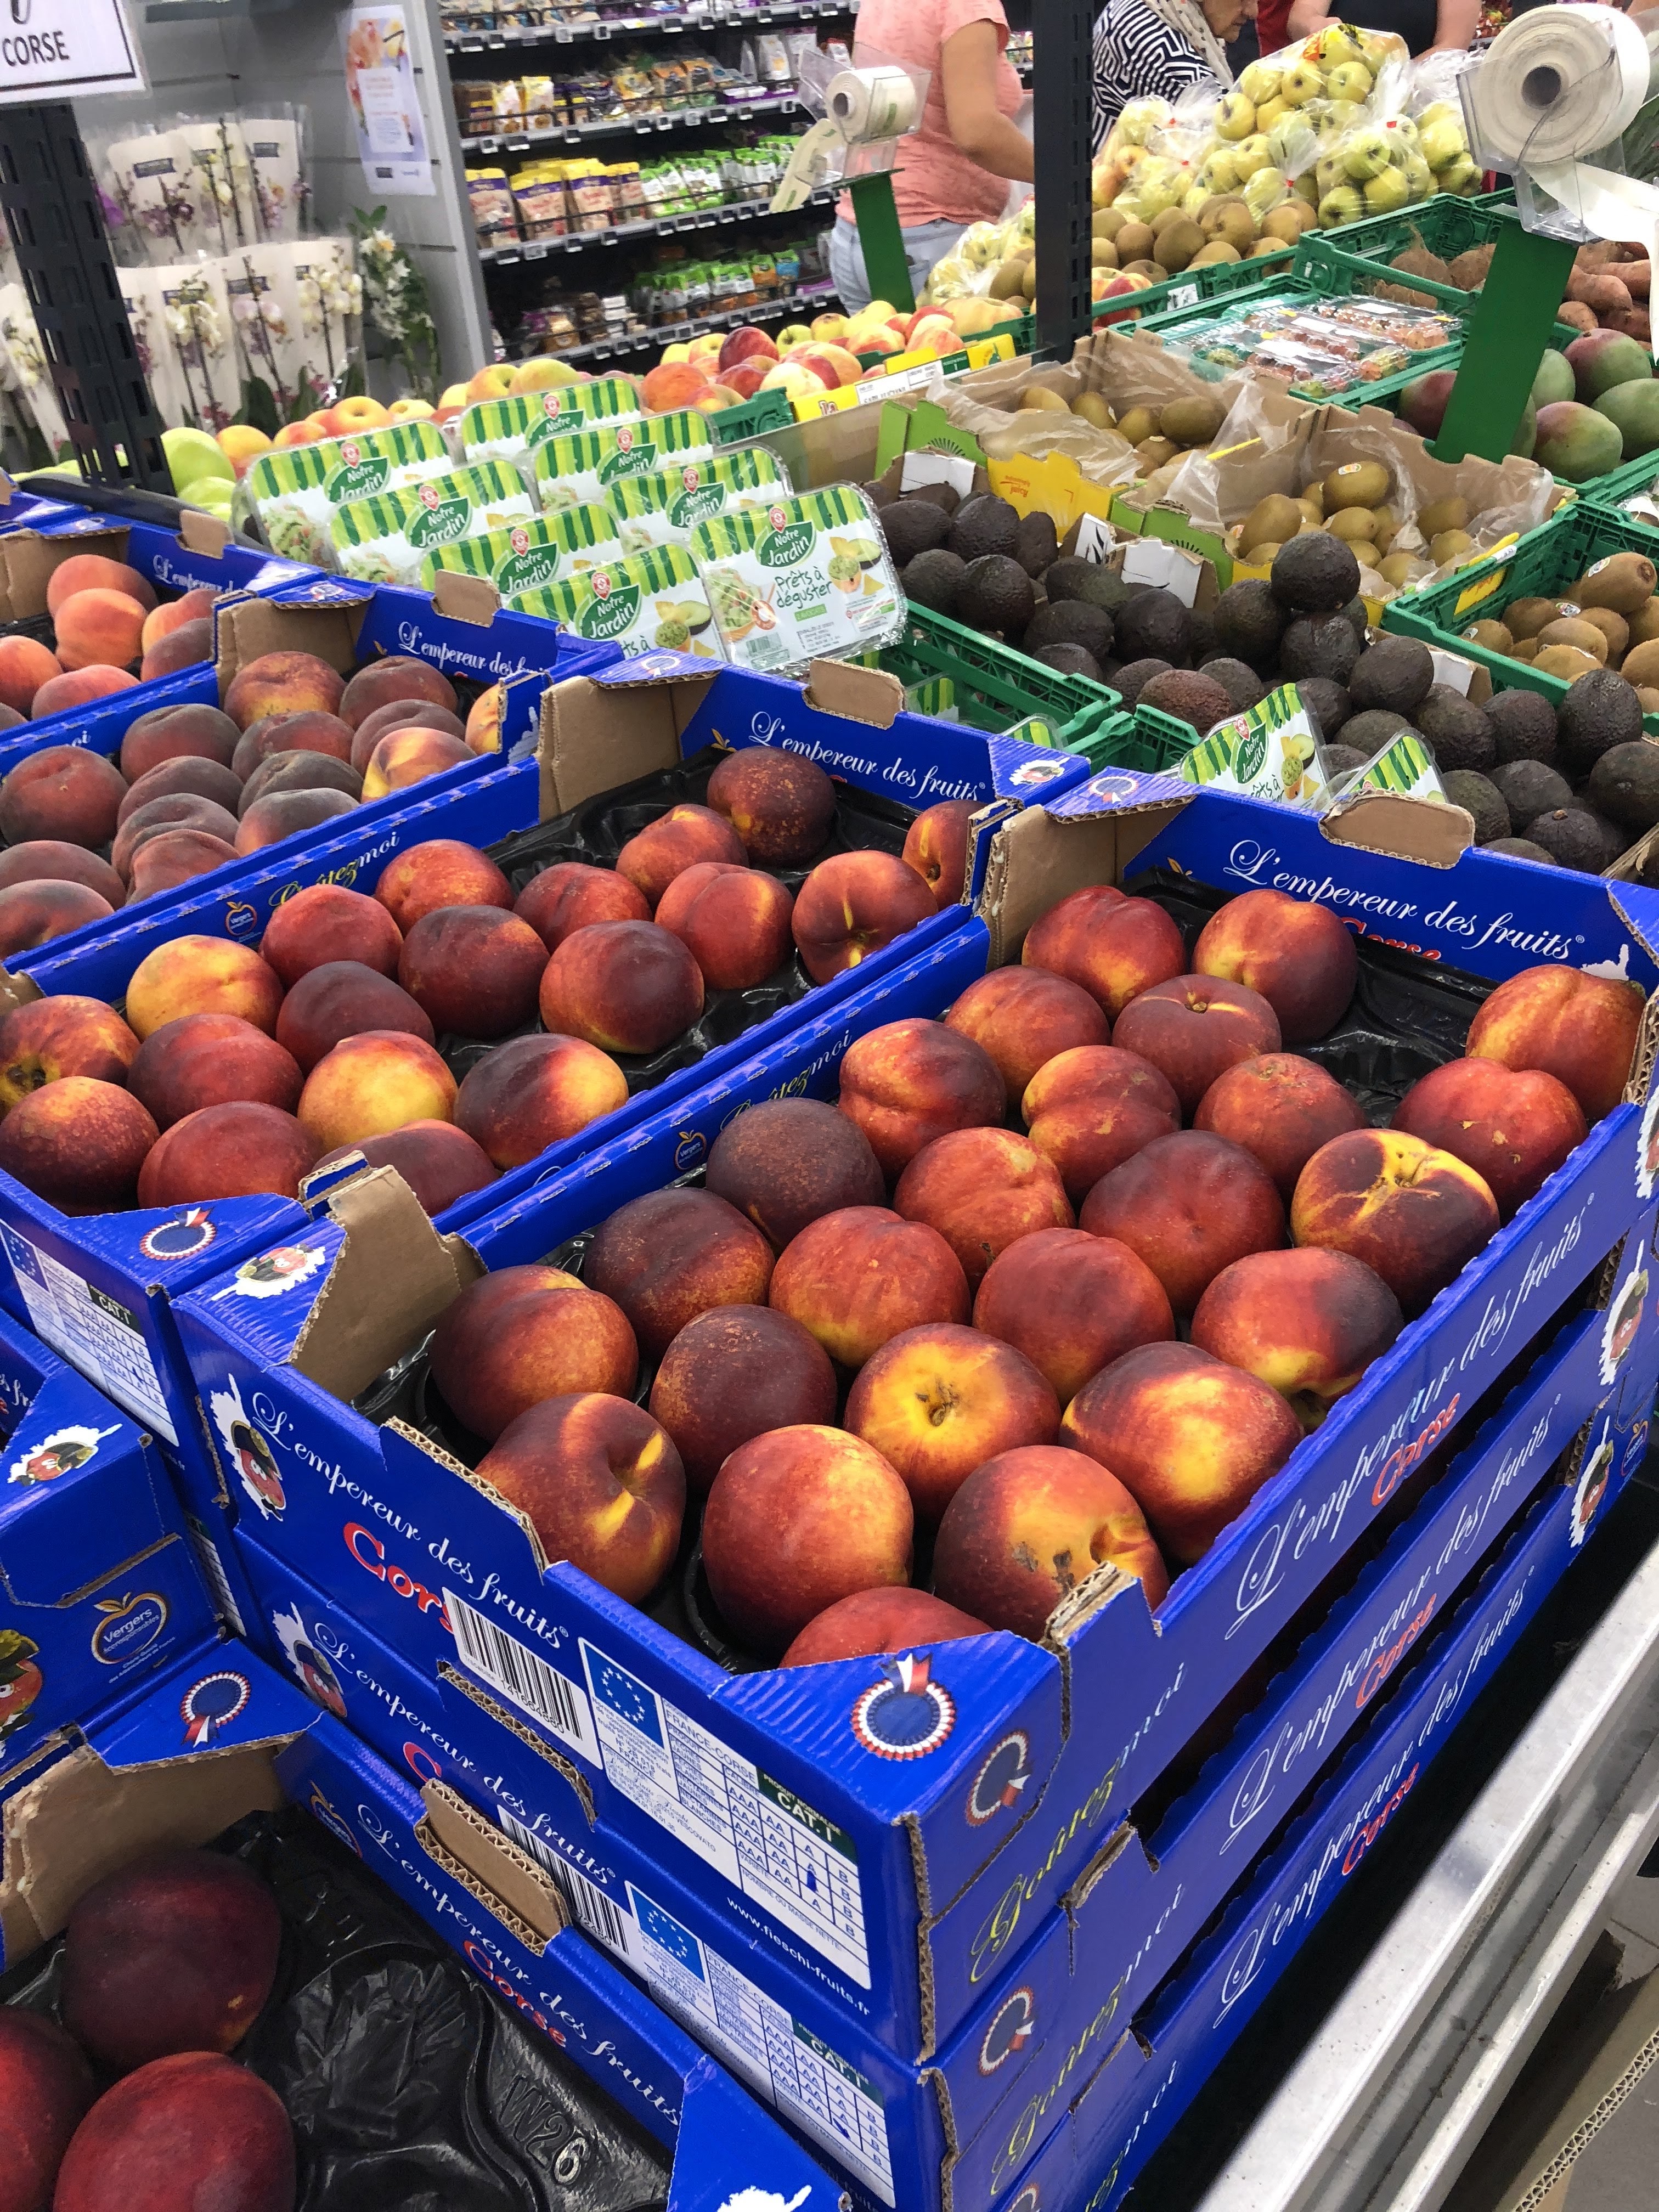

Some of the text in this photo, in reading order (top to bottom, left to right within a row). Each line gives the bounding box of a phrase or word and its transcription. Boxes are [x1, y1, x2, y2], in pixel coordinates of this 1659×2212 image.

[2, 30, 70, 66] CORSE
[546, 417, 571, 432] Notre
[347, 462, 374, 483] Notre
[618, 451, 643, 467] Notre
[428, 504, 455, 527] Notre
[678, 498, 720, 528] Jardin
[685, 490, 711, 508] Notre
[420, 514, 466, 548] Jardin
[768, 536, 810, 566] Jardin
[775, 529, 800, 547] Notre
[505, 559, 552, 595] Jardin
[515, 551, 542, 572] Notre
[775, 566, 825, 592] Prêts à
[597, 595, 625, 618] Notre
[776, 581, 833, 609] déguster
[590, 603, 637, 639] Jardin
[398, 621, 487, 669] L'empereur
[489, 651, 512, 675] des
[748, 712, 878, 775] L'empereur
[883, 757, 917, 787] des
[1242, 741, 1265, 782] Jardin
[1245, 735, 1260, 759] Notre
[1222, 839, 1417, 919] L'empereur
[1425, 900, 1477, 936] des
[1224, 1357, 1455, 1641] L'empereur
[1460, 1289, 1512, 1372] des
[1372, 1392, 1462, 1506] Corse
[251, 1391, 421, 1541] L'empereur
[428, 1538, 474, 1584] des
[342, 1521, 454, 1635] Cor
[103, 1608, 153, 1643] Vergers
[1356, 1593, 1437, 1709] Corse
[1218, 1566, 1431, 1856] L'empereur
[1435, 1495, 1482, 1575] des
[314, 1622, 476, 1773] L'empereur
[483, 1776, 526, 1816] des
[592, 1696, 614, 1717] Norme
[596, 1706, 605, 1715] de
[597, 1717, 616, 1735] fruits
[656, 1762, 672, 1779] frais
[619, 1746, 655, 1779] FRANCE
[665, 1709, 755, 1784] FRANCE-CORSE
[777, 1791, 821, 1833] CAT.
[1341, 1762, 1419, 1875] Corse
[729, 1786, 848, 1883] AAA AA A B
[732, 1804, 759, 1831] AAA
[769, 1833, 788, 1853] AA
[841, 1887, 850, 1901] B
[1212, 1740, 1413, 2029] L'empereur
[1418, 1669, 1463, 1747] des
[735, 1822, 853, 1919] AAA AA B
[738, 1840, 855, 1937] AAA AA A B
[742, 1869, 775, 1898] NOMBRE
[775, 1895, 787, 1908] OU
[788, 1904, 814, 1929] MASSE
[357, 1803, 532, 1986] L'empereur
[539, 1991, 587, 2040] des
[583, 2041, 680, 2126] fruits
[726, 1896, 870, 2016] www.fieschi-fruits.fr
[462, 1939, 567, 2048] Corse
